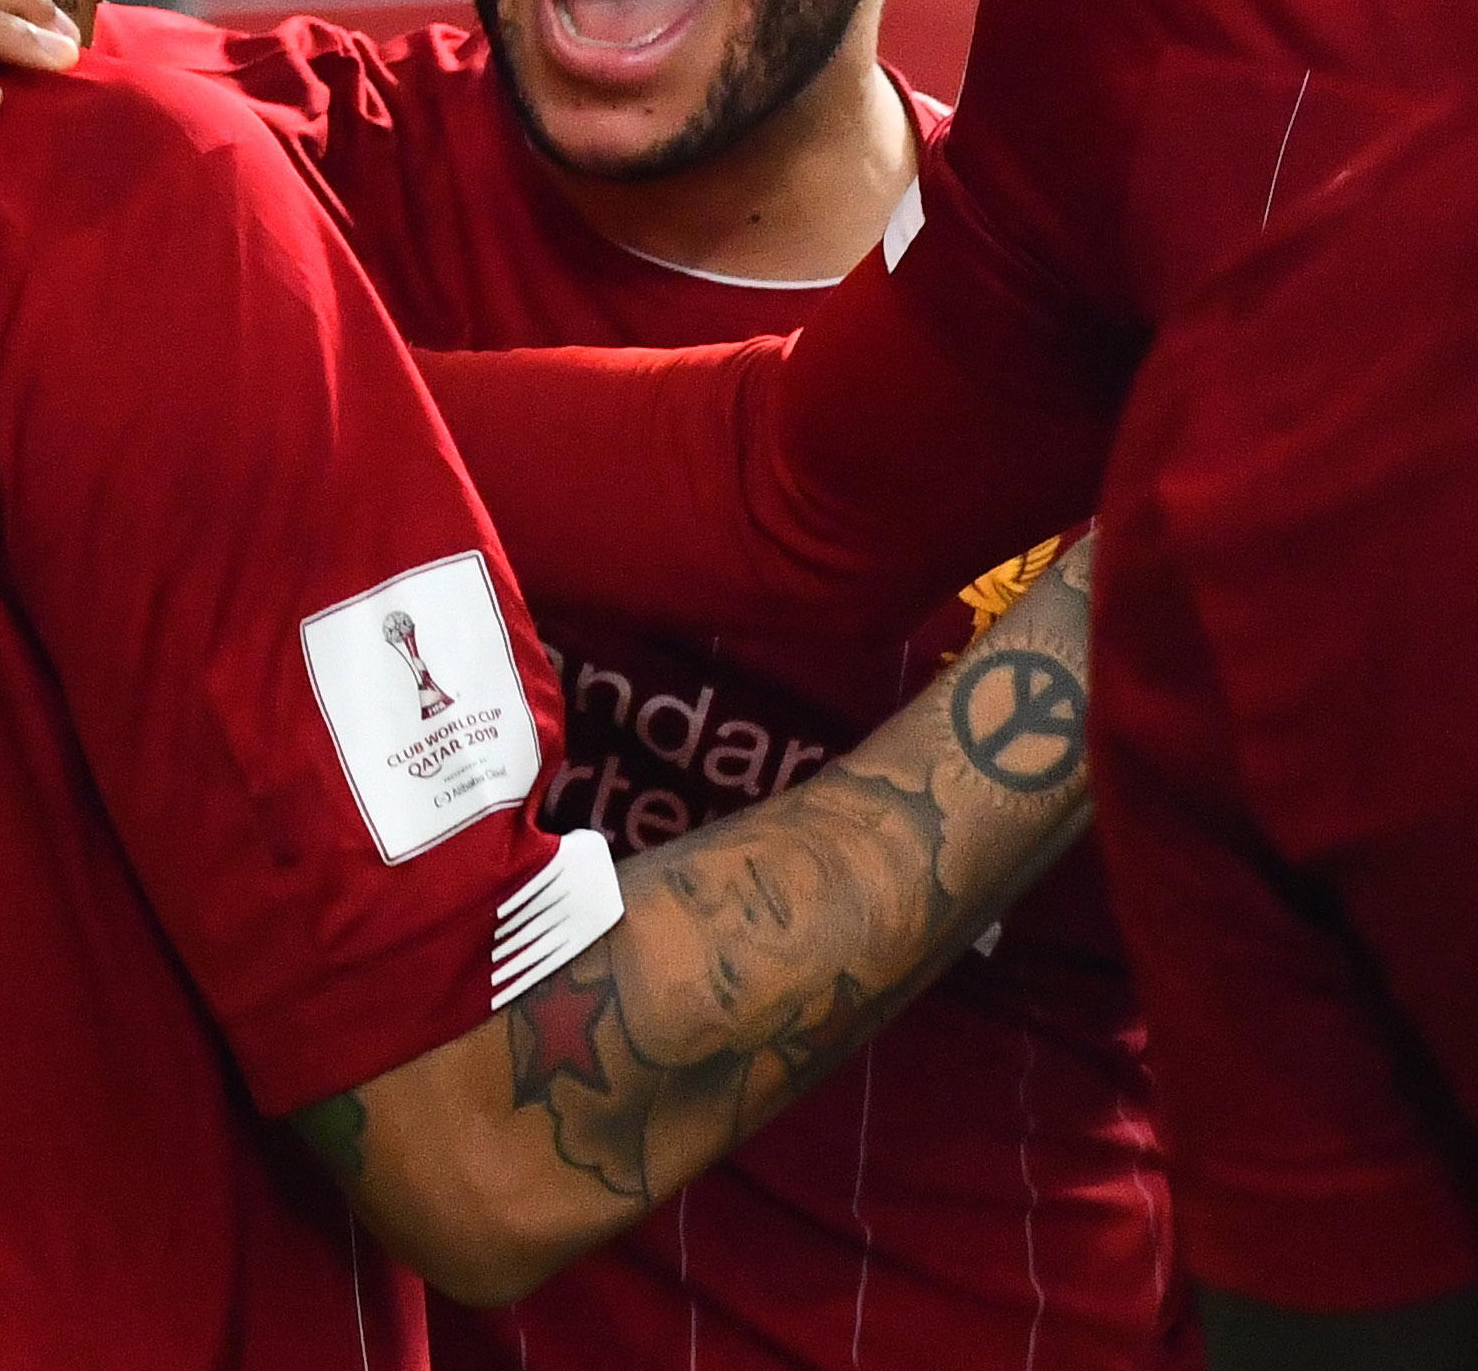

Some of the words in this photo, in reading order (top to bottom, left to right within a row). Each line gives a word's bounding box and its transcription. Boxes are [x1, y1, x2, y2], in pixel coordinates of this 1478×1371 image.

[386, 741, 424, 768] CLUB
[424, 714, 477, 747] WORLD
[478, 708, 502, 723] CUP
[408, 739, 463, 778] QATAR
[465, 726, 499, 746] 2019
